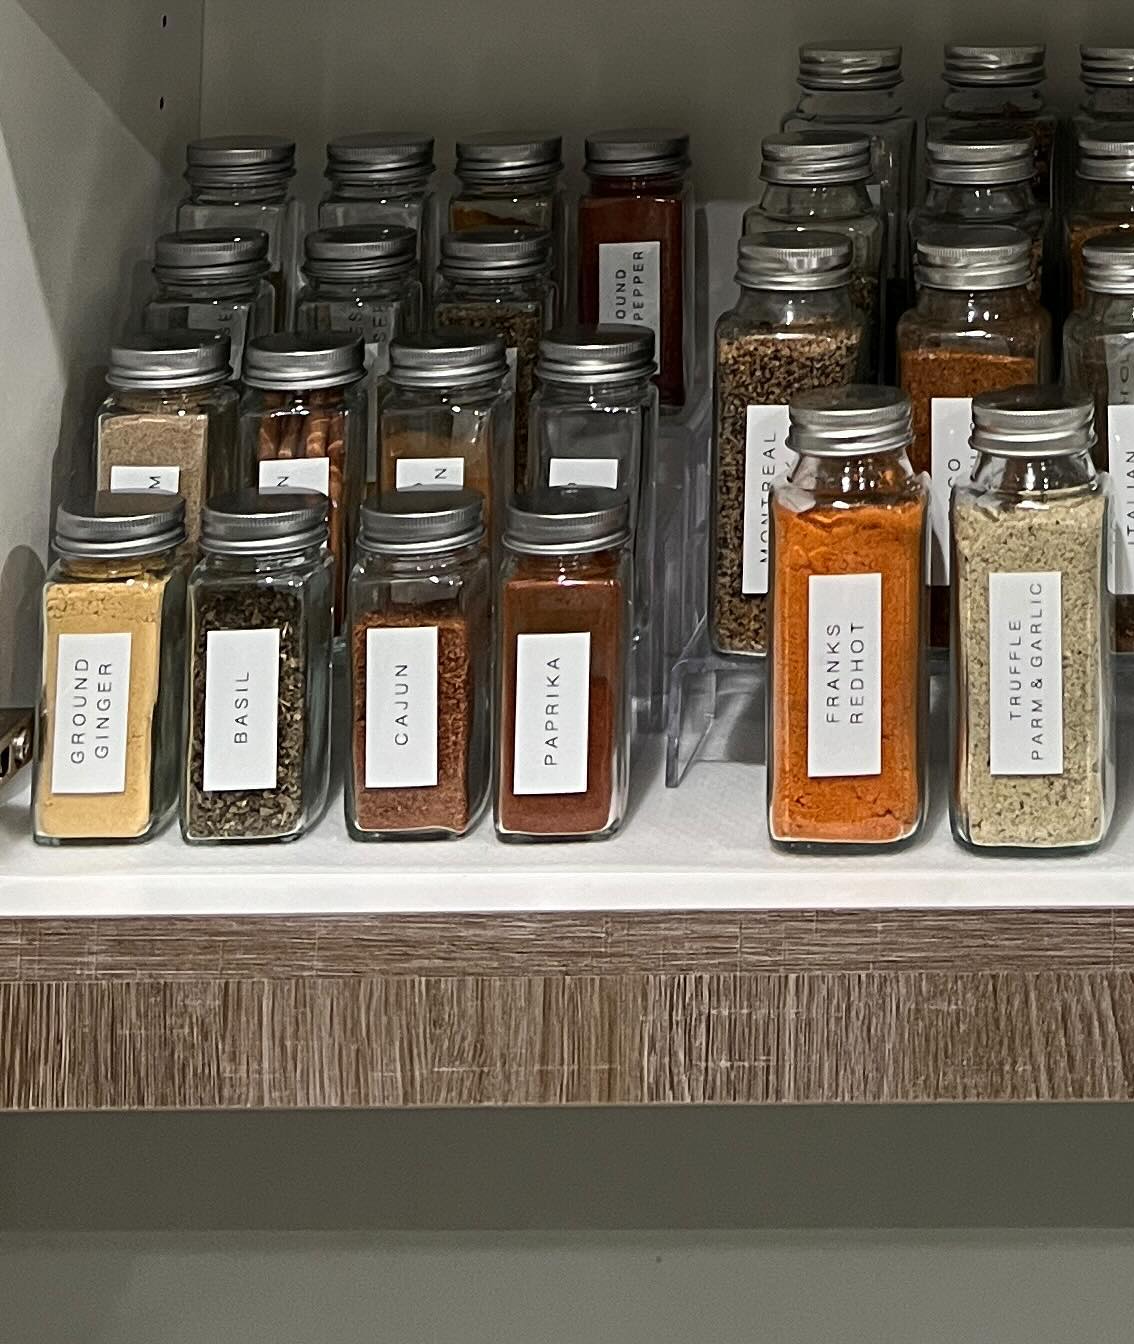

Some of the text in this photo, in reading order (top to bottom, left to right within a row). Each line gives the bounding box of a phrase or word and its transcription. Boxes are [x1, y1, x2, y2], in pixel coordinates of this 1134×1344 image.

[615, 268, 627, 320] OUND
[633, 250, 644, 321] PEPPER
[70, 658, 89, 764] GROUND
[94, 663, 112, 759] GINGER
[233, 671, 250, 744] BASIL
[394, 664, 409, 746] CAJUN
[544, 657, 560, 766] PAPRIKA
[826, 624, 841, 724] FRANKS
[849, 623, 865, 725] REDHOT
[1008, 620, 1022, 721] TRUFFLE
[1030, 583, 1044, 760] PARM & GARLIC
